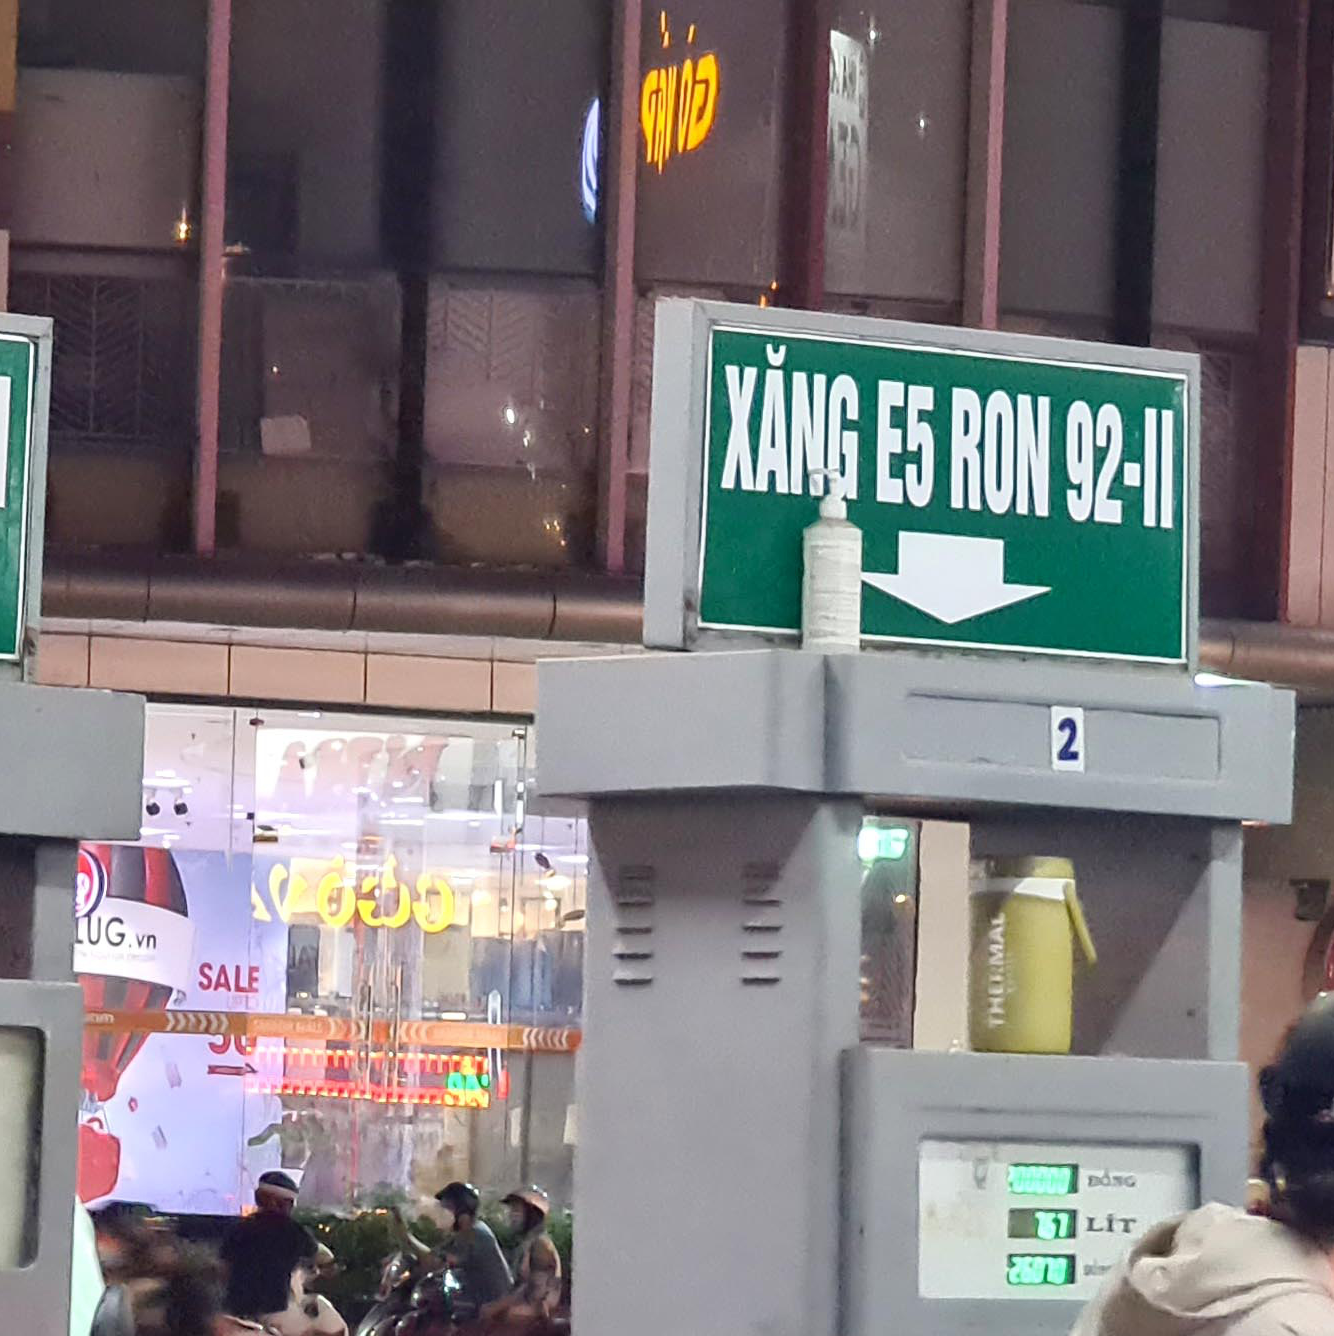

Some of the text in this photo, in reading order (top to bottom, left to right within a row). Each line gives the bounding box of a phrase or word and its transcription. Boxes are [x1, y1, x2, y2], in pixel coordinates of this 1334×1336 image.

[721, 344, 1173, 529] XĂNG E5 RON 92-II
[1057, 717, 1079, 761] 2
[198, 961, 260, 994] SALE
